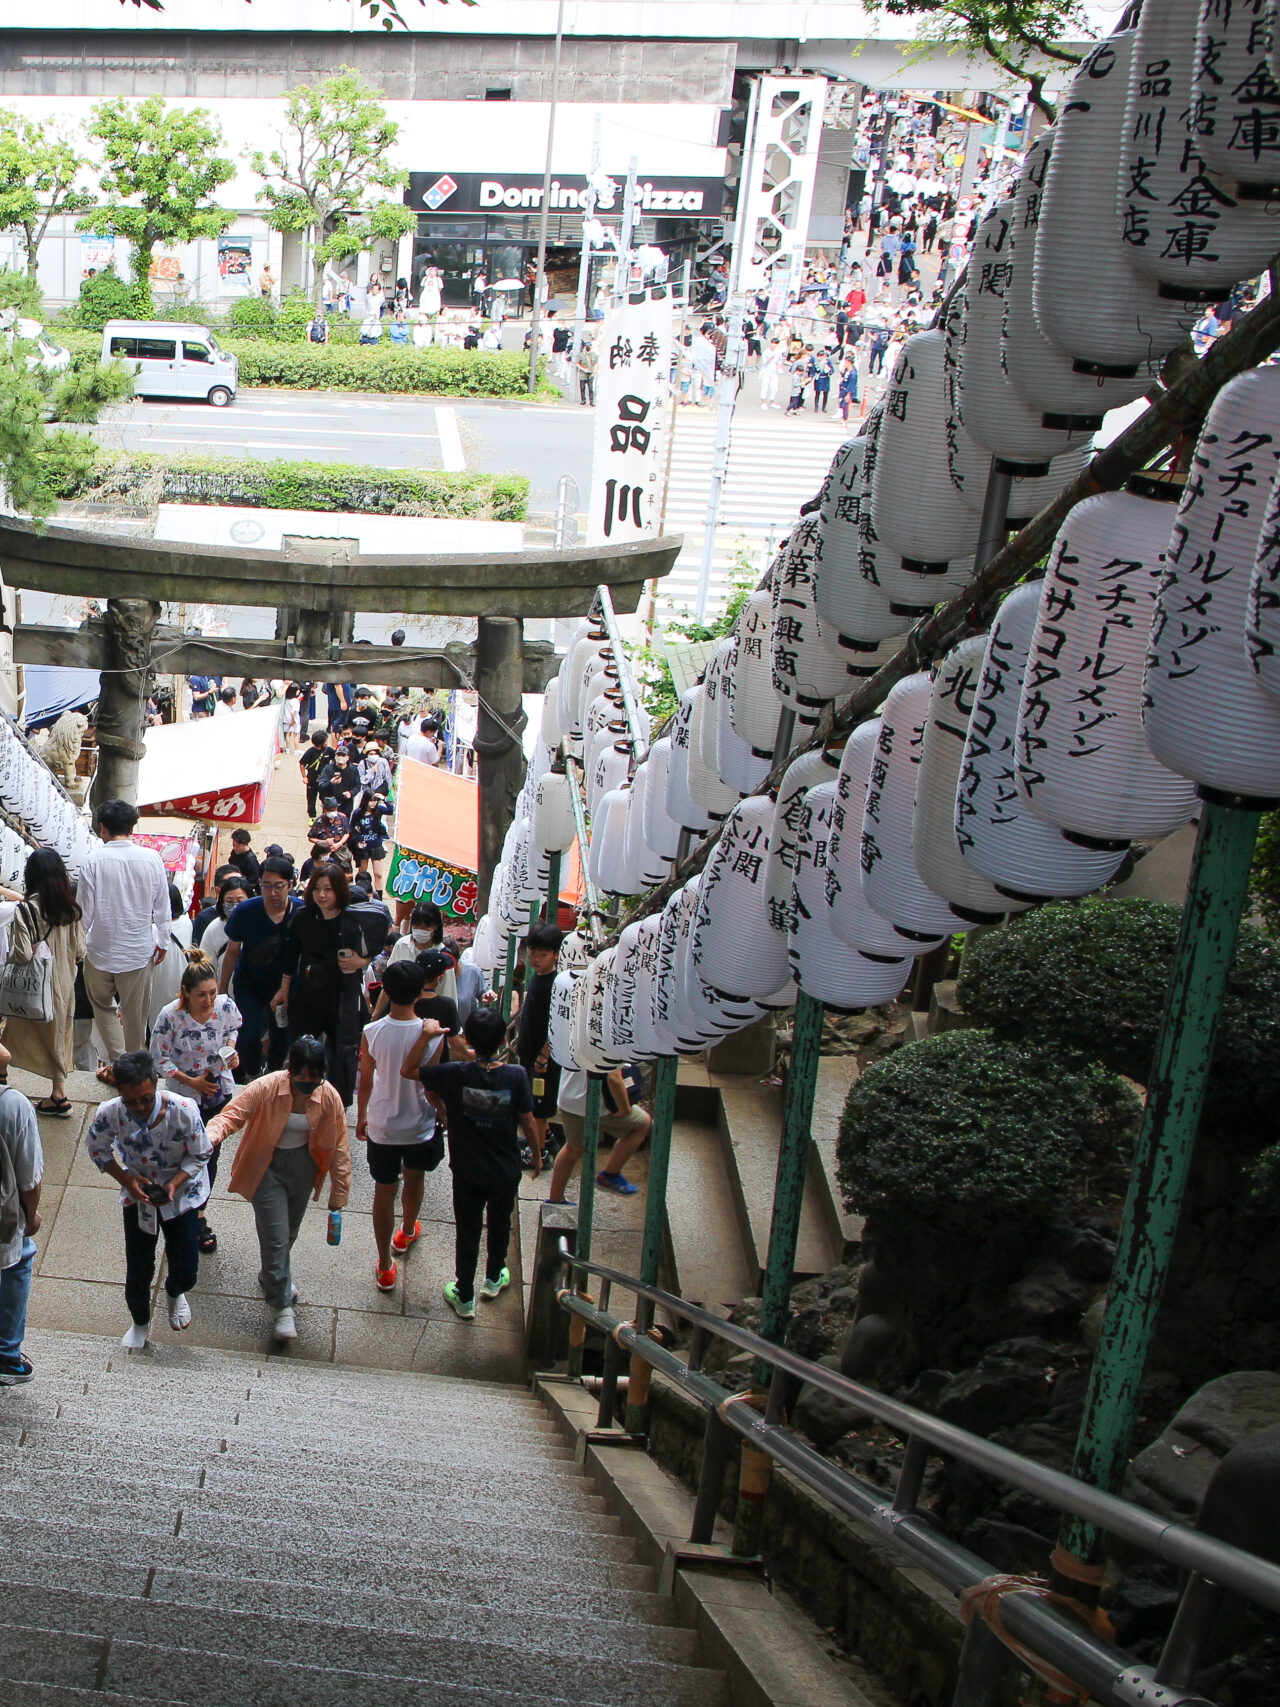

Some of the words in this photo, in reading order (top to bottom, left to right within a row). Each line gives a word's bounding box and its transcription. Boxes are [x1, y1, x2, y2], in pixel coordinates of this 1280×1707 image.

[479, 181, 616, 209] Dominos
[1121, 59, 1171, 248] 品川支店
[885, 356, 916, 422] 小関
[1167, 430, 1272, 679] クチュールメゾン
[744, 612, 766, 659] 小関
[1018, 540, 1079, 798] ヒサコタカヤマ
[1068, 558, 1143, 758] クチュールメゾン
[732, 826, 770, 884] 小関
